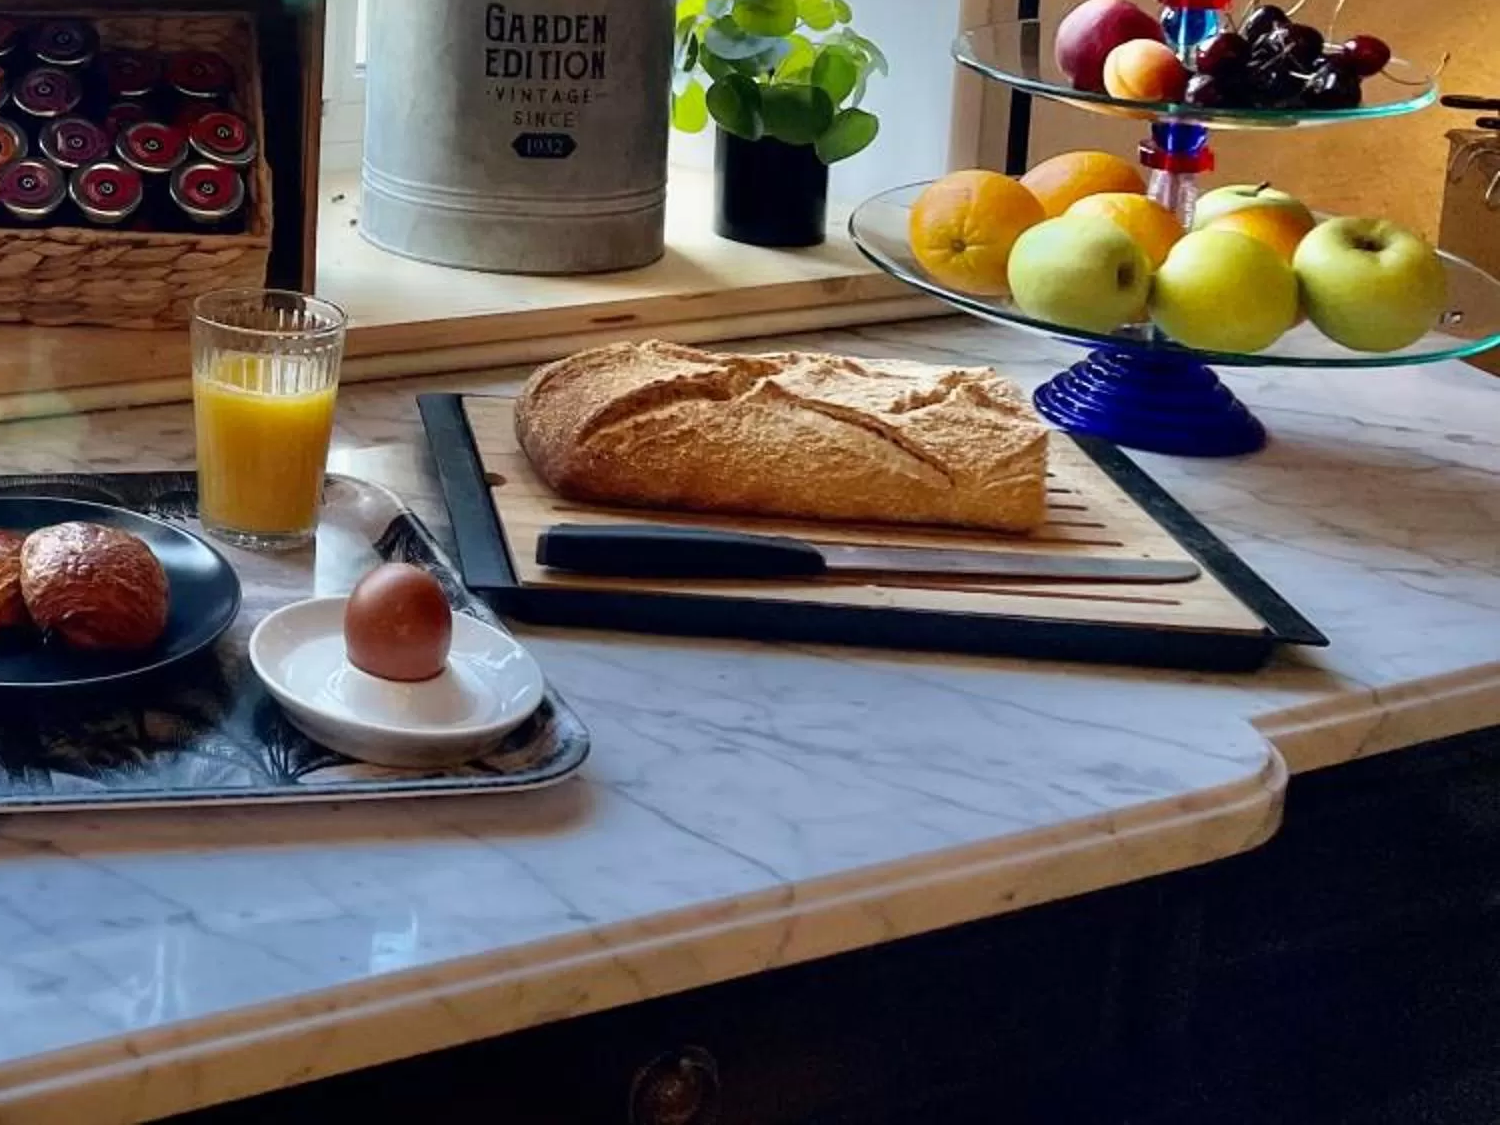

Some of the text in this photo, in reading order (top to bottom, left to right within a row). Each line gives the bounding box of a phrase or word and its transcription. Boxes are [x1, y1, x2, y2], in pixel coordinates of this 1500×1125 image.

[485, 2, 608, 44] GARDEN
[484, 48, 607, 80] EDITION
[512, 110, 575, 128] SINCE
